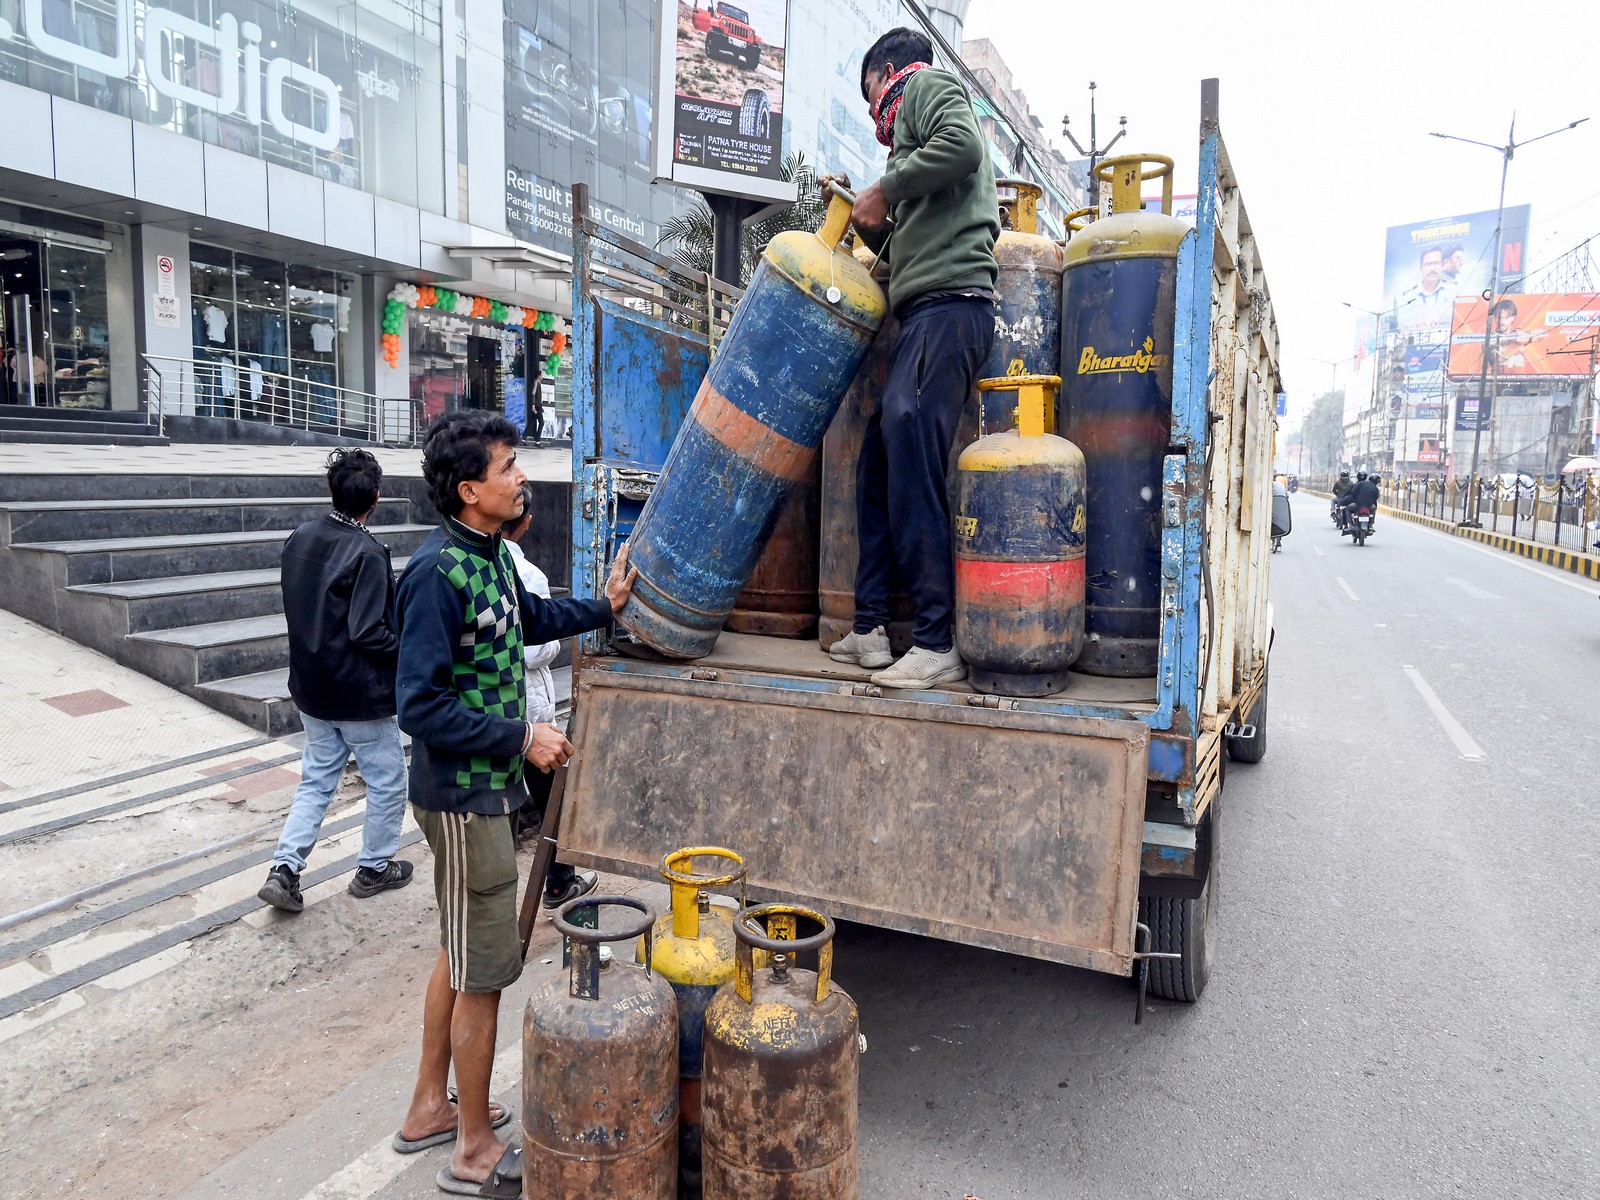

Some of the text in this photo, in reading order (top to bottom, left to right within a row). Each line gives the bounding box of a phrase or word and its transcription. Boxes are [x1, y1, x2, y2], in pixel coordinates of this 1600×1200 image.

[0, 0, 340, 151] udio
[708, 135, 730, 147] PATNA
[731, 138, 749, 150] TYRE
[749, 142, 772, 154] HOUSE
[506, 169, 645, 237] Renault Pna Central
[506, 192, 537, 214] Pandey
[538, 203, 561, 221] Plaza,
[507, 207, 521, 221] Tel.
[524, 213, 573, 238] 7360002216
[1503, 242, 1522, 273] N
[1077, 345, 1169, 375] Bharatgas
